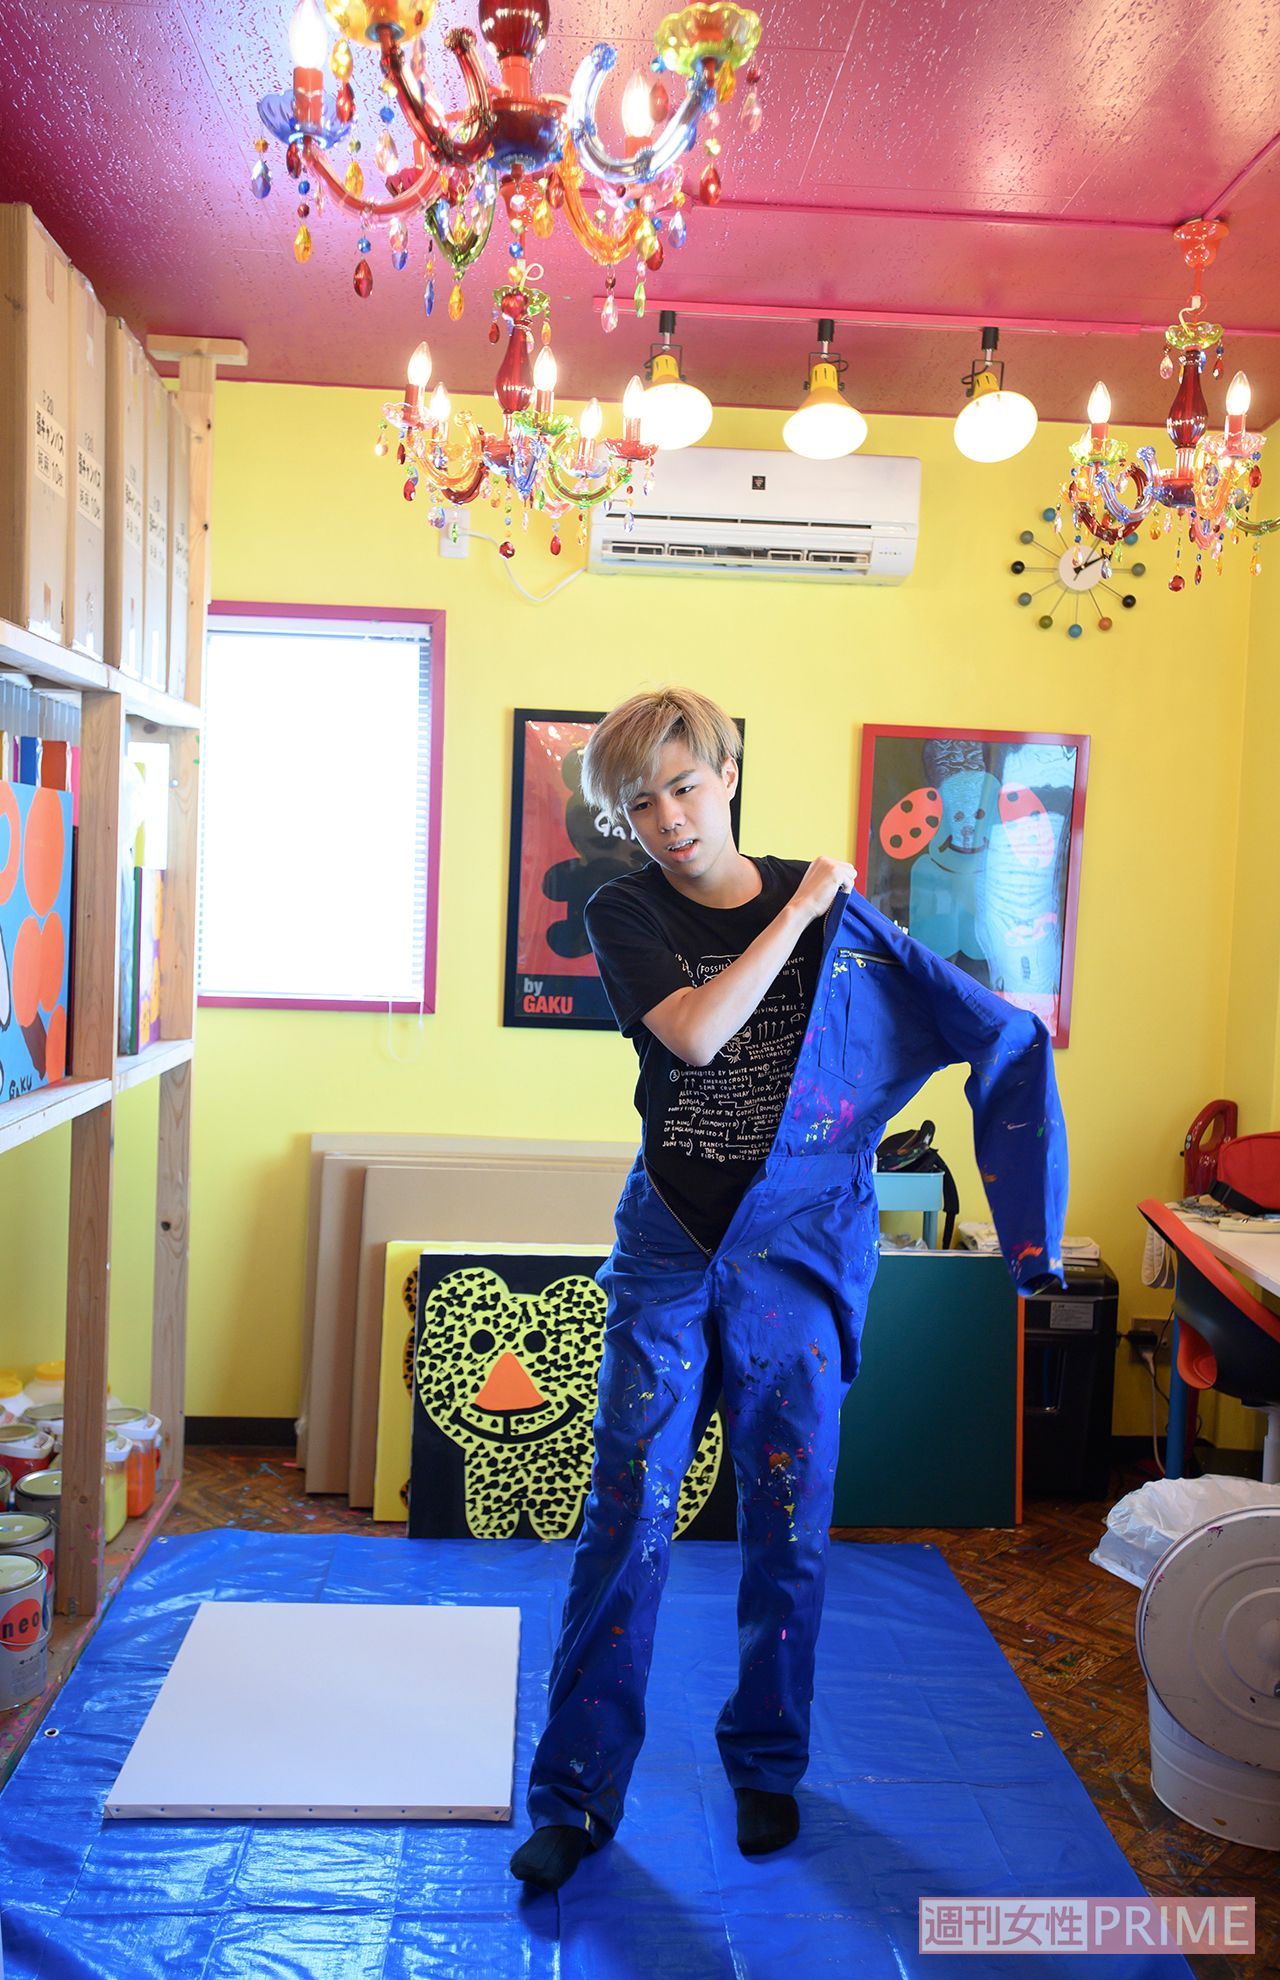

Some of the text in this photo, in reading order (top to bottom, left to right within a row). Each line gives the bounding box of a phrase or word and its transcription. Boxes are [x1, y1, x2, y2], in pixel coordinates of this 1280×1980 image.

[523, 977, 543, 996] by
[523, 994, 573, 1015] GAKU
[728, 1067, 748, 1076] WHITE
[728, 1075, 749, 1084] CROSS
[700, 1141, 724, 1149] FRANCIS
[3, 1612, 39, 1639] neo
